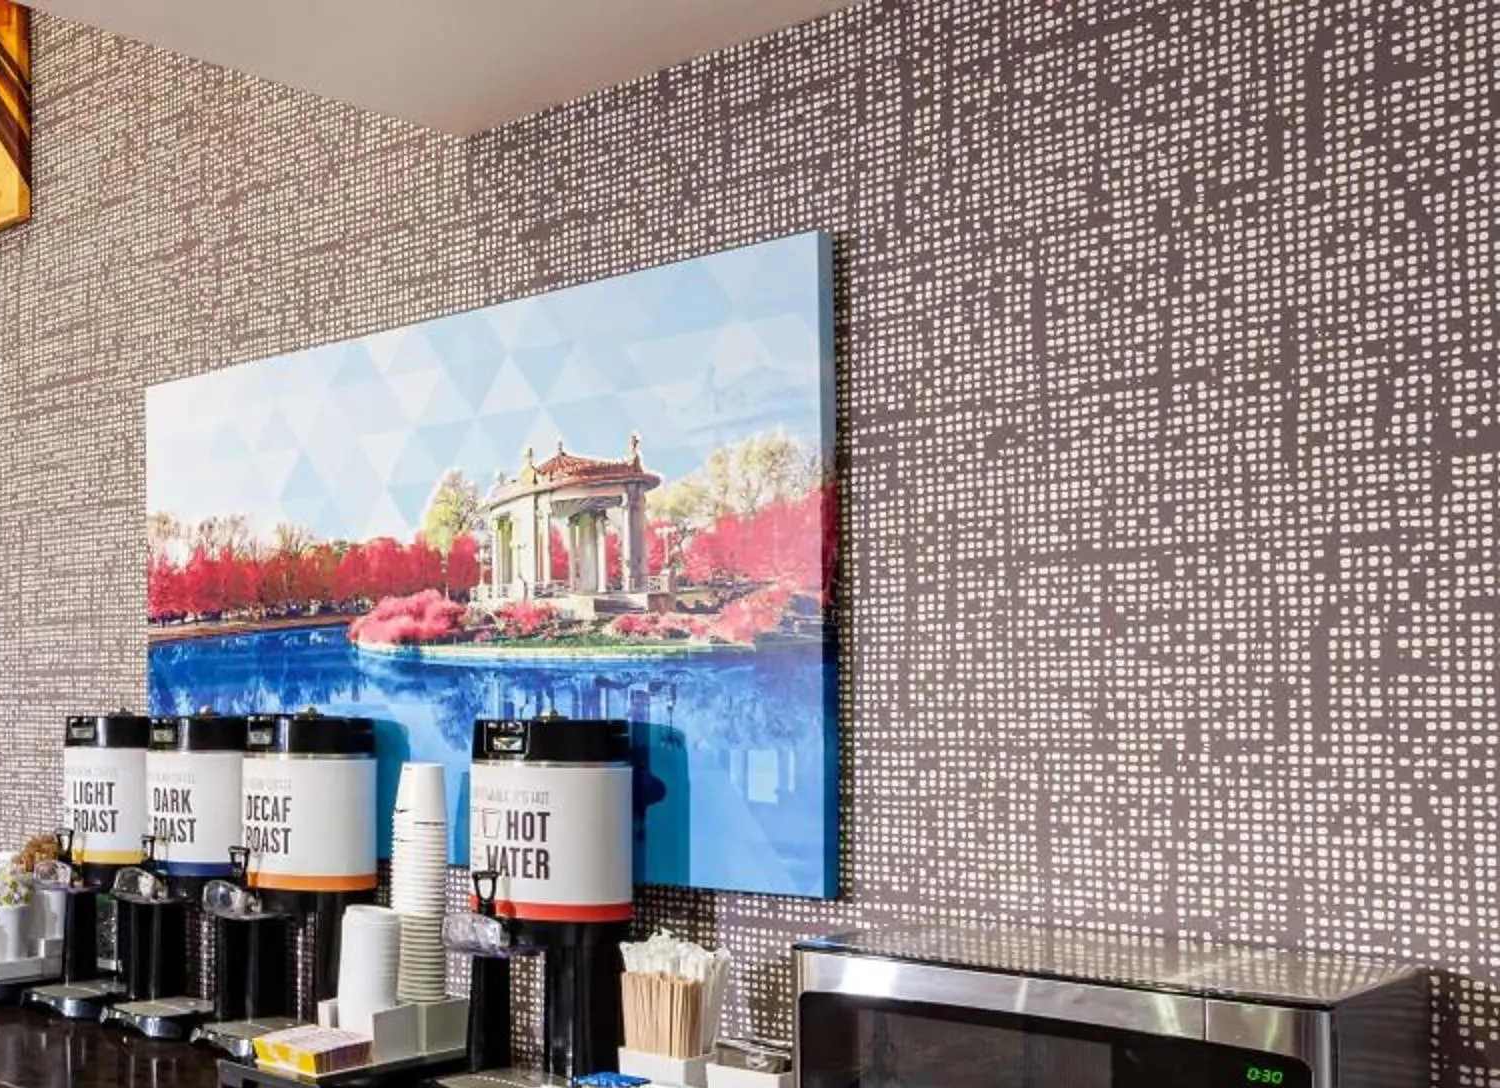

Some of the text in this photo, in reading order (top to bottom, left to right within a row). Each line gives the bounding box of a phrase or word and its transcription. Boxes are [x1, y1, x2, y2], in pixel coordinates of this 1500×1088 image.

[73, 781, 115, 805] LIGHT
[153, 787, 192, 814] DARK
[73, 809, 119, 833] ROAST
[245, 795, 293, 823] DECAF
[153, 816, 197, 844] ROAST
[245, 826, 292, 855] ROAST
[506, 810, 551, 843] HOT
[486, 844, 550, 880] WATER
